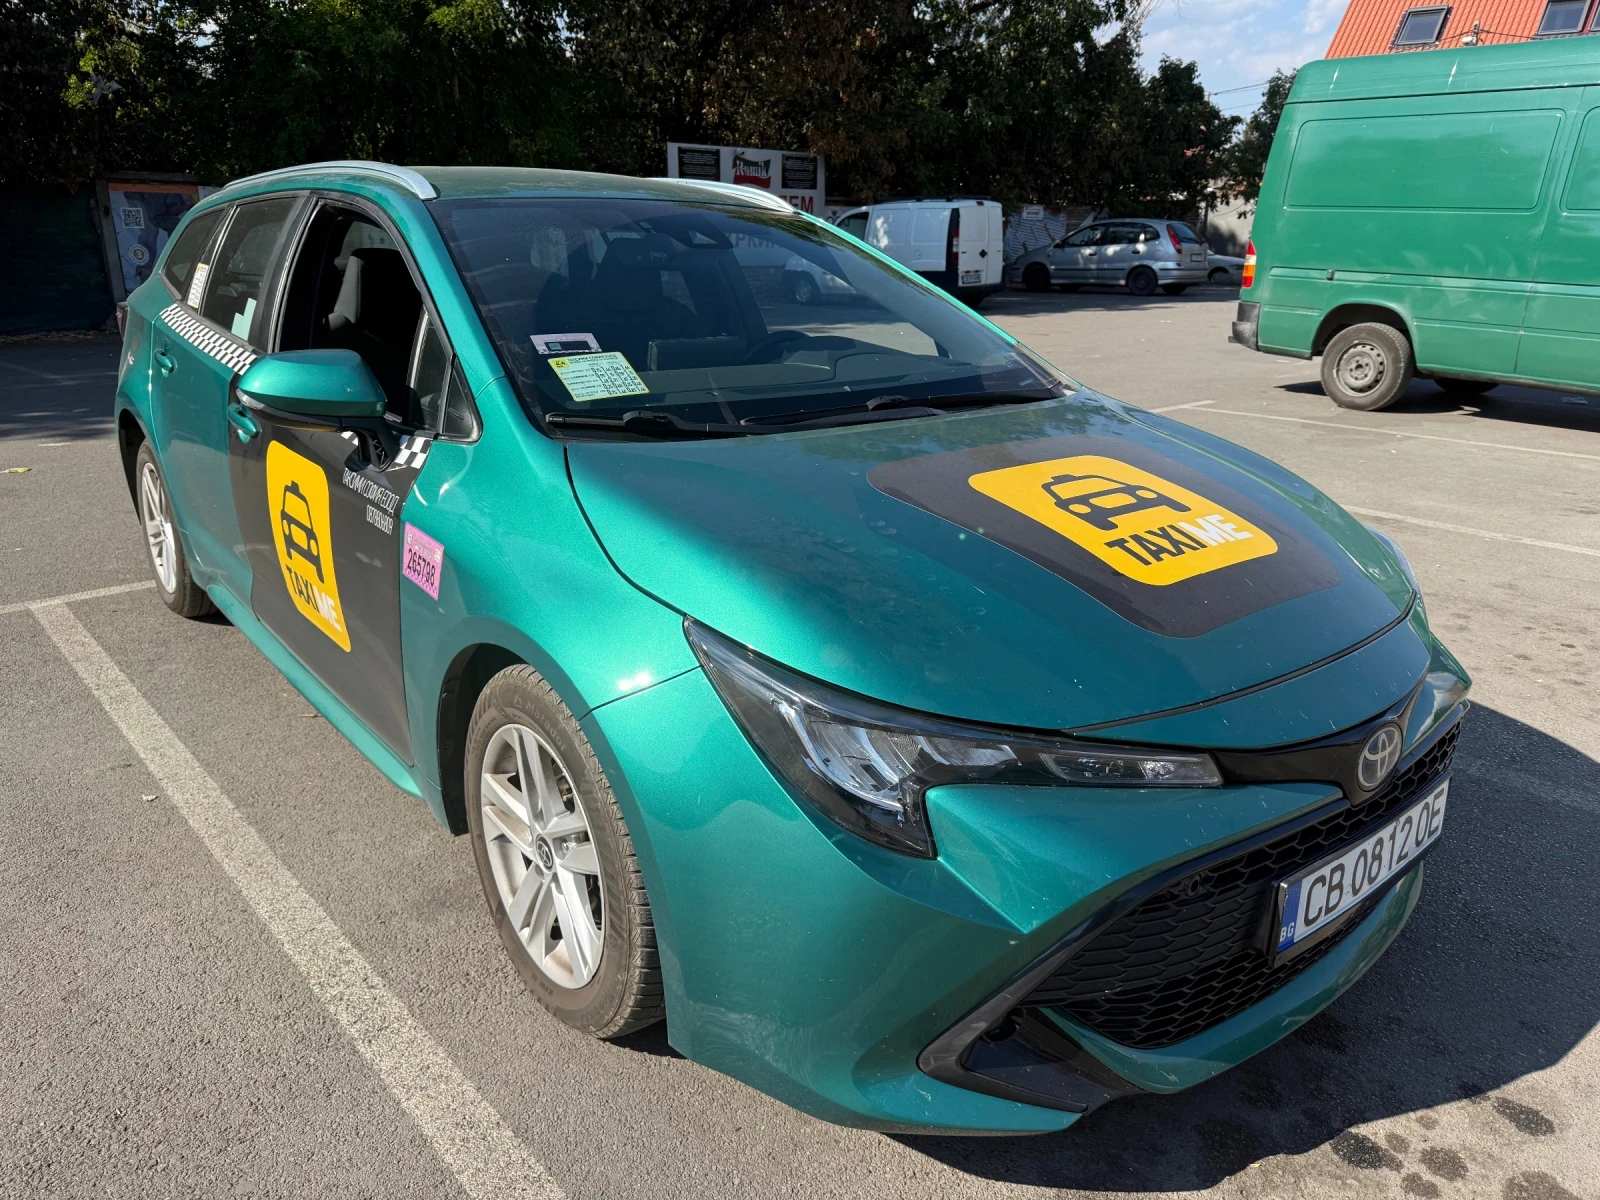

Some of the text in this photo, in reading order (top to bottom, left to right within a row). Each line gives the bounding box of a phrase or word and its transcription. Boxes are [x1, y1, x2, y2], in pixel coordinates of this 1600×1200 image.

[1104, 514, 1254, 567] TAXIME
[406, 548, 436, 587] 265798
[285, 563, 343, 633] TAXIME
[525, 702, 567, 752] Matador
[1303, 787, 1445, 928] CB 0812 OE
[1280, 922, 1295, 942] BG
